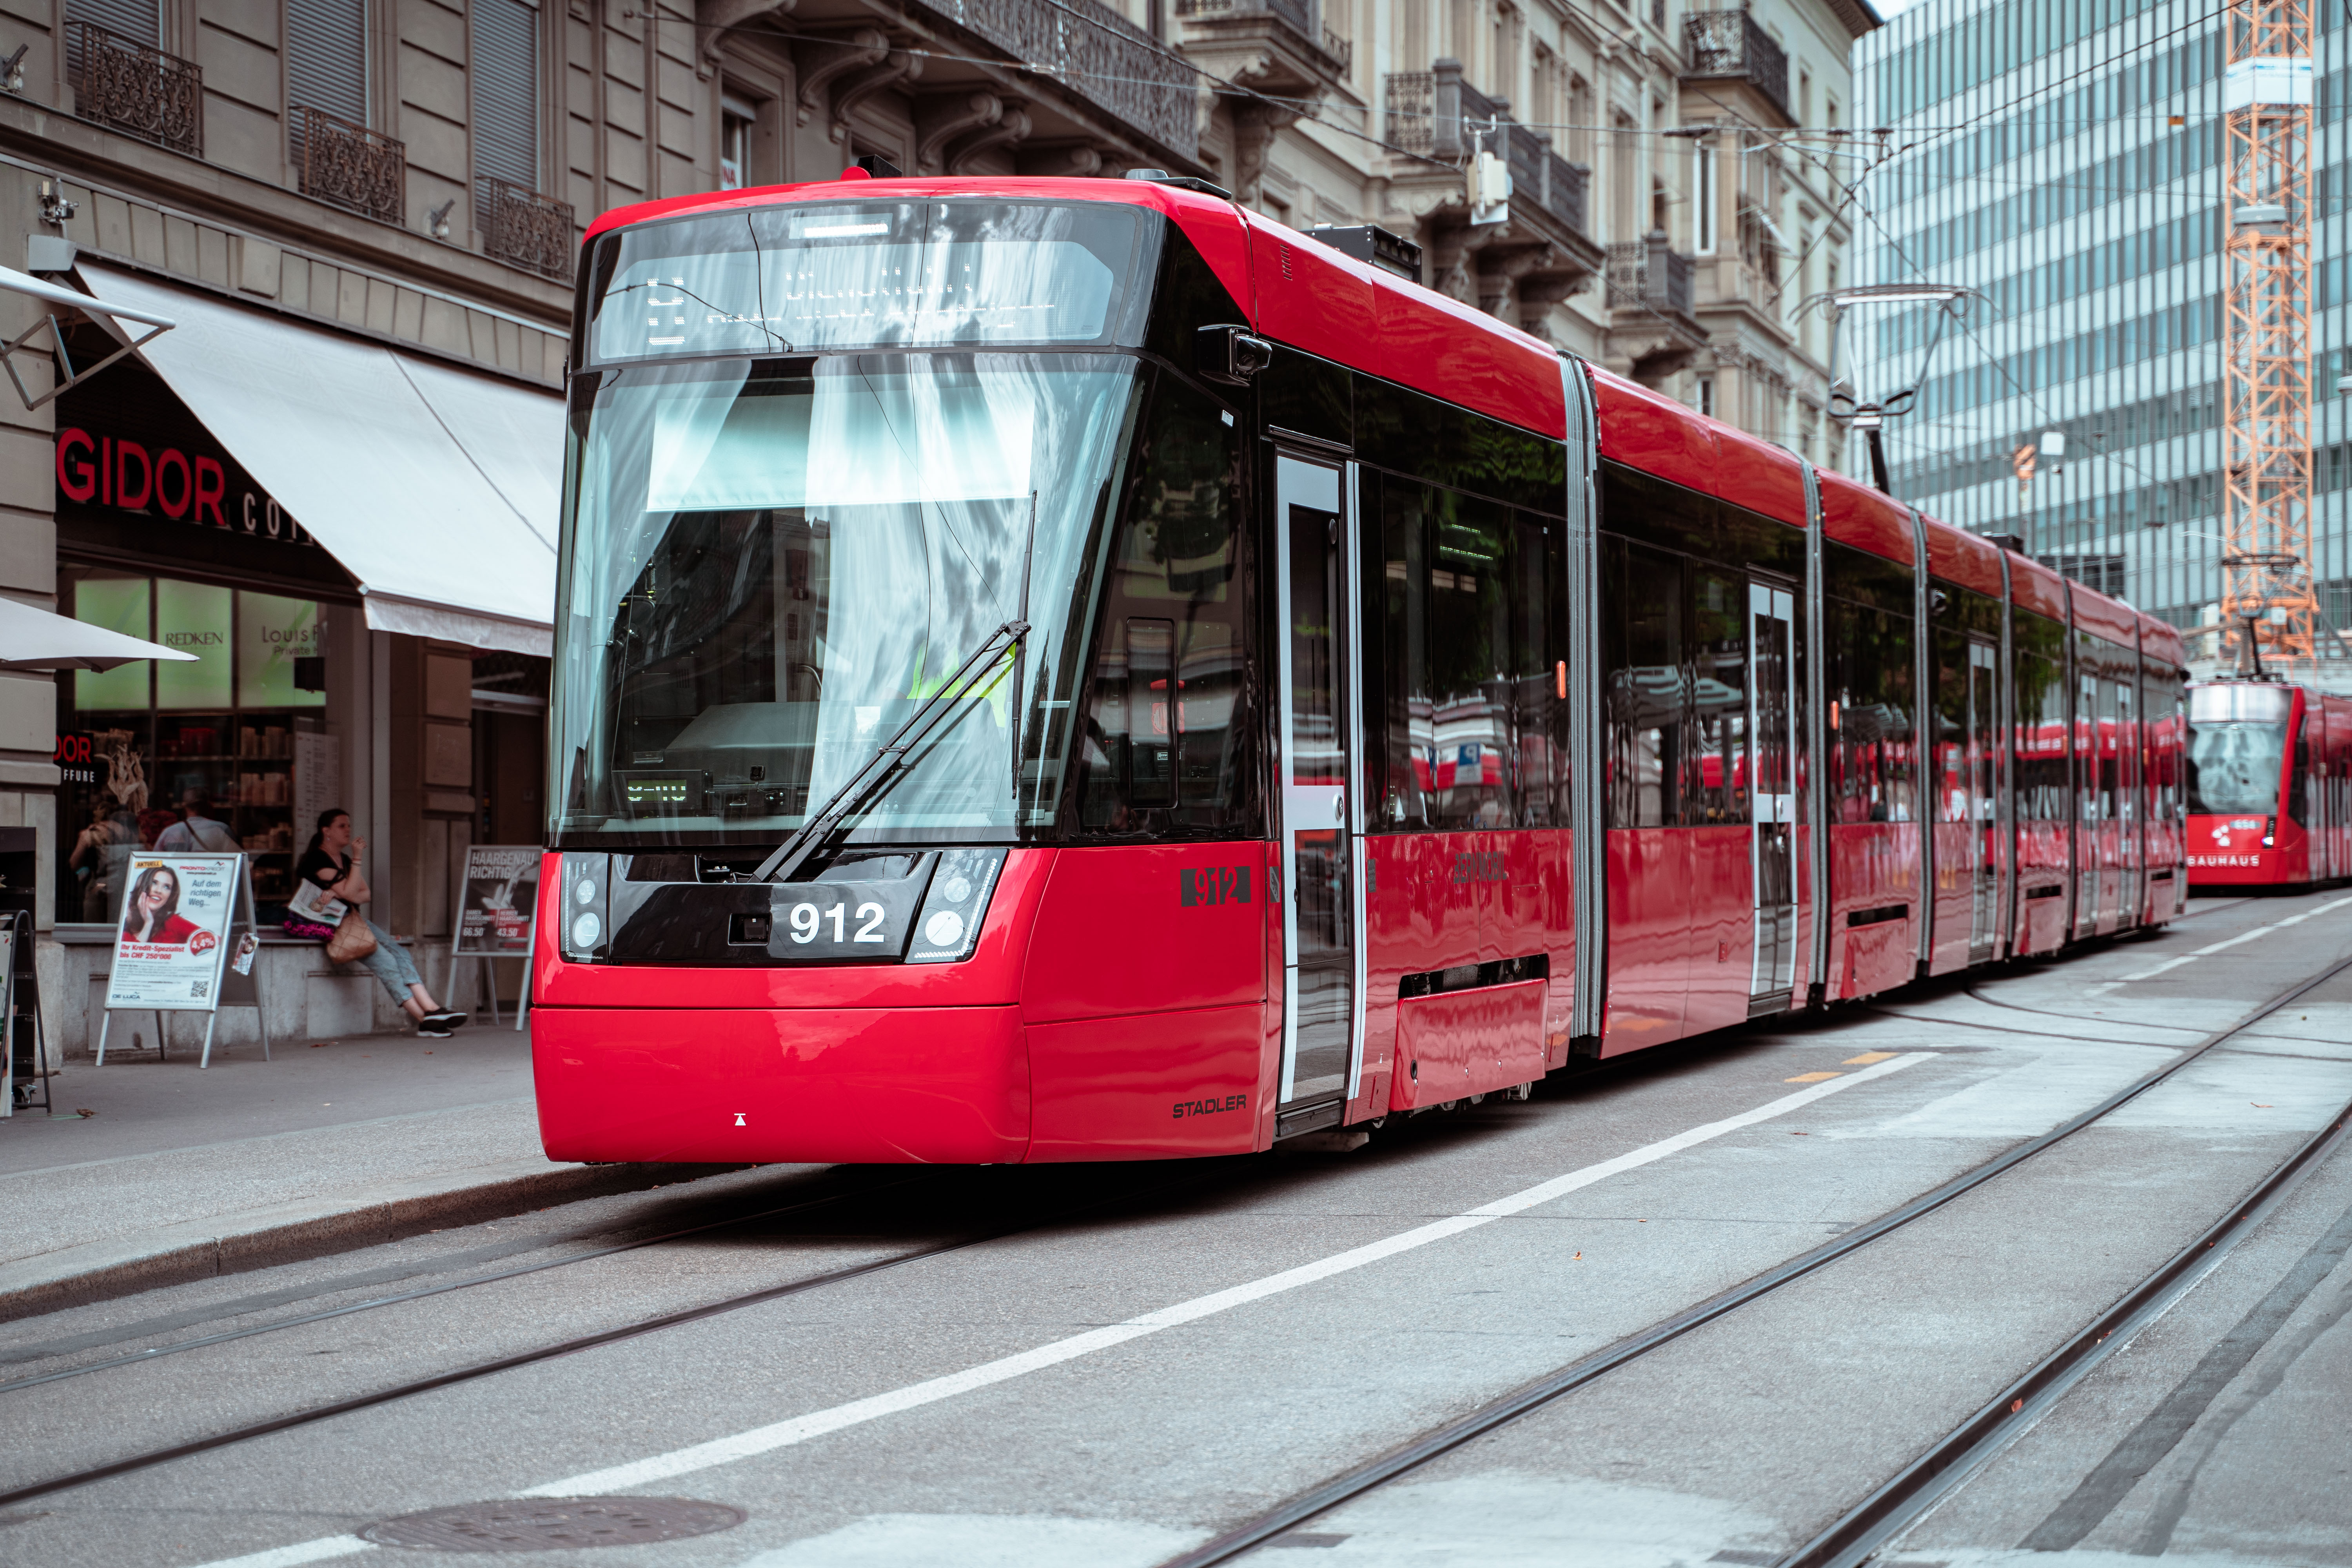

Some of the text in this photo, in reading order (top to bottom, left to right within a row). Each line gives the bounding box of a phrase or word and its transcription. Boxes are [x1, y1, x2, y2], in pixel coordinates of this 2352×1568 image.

[56, 428, 226, 526] GIDOR
[165, 632, 223, 646] REDKEN
[472, 852, 535, 865] HAARGENAU
[2187, 855, 2260, 867] BAUHAUS
[470, 866, 511, 879] RICHTIG
[1454, 851, 1507, 884] BERNMOBIL
[1194, 866, 1239, 906] 912
[190, 890, 221, 899] richtigen
[789, 902, 886, 945] 912
[132, 944, 185, 953] Kredit-Spezialist
[1173, 1094, 1246, 1118] STADLER
